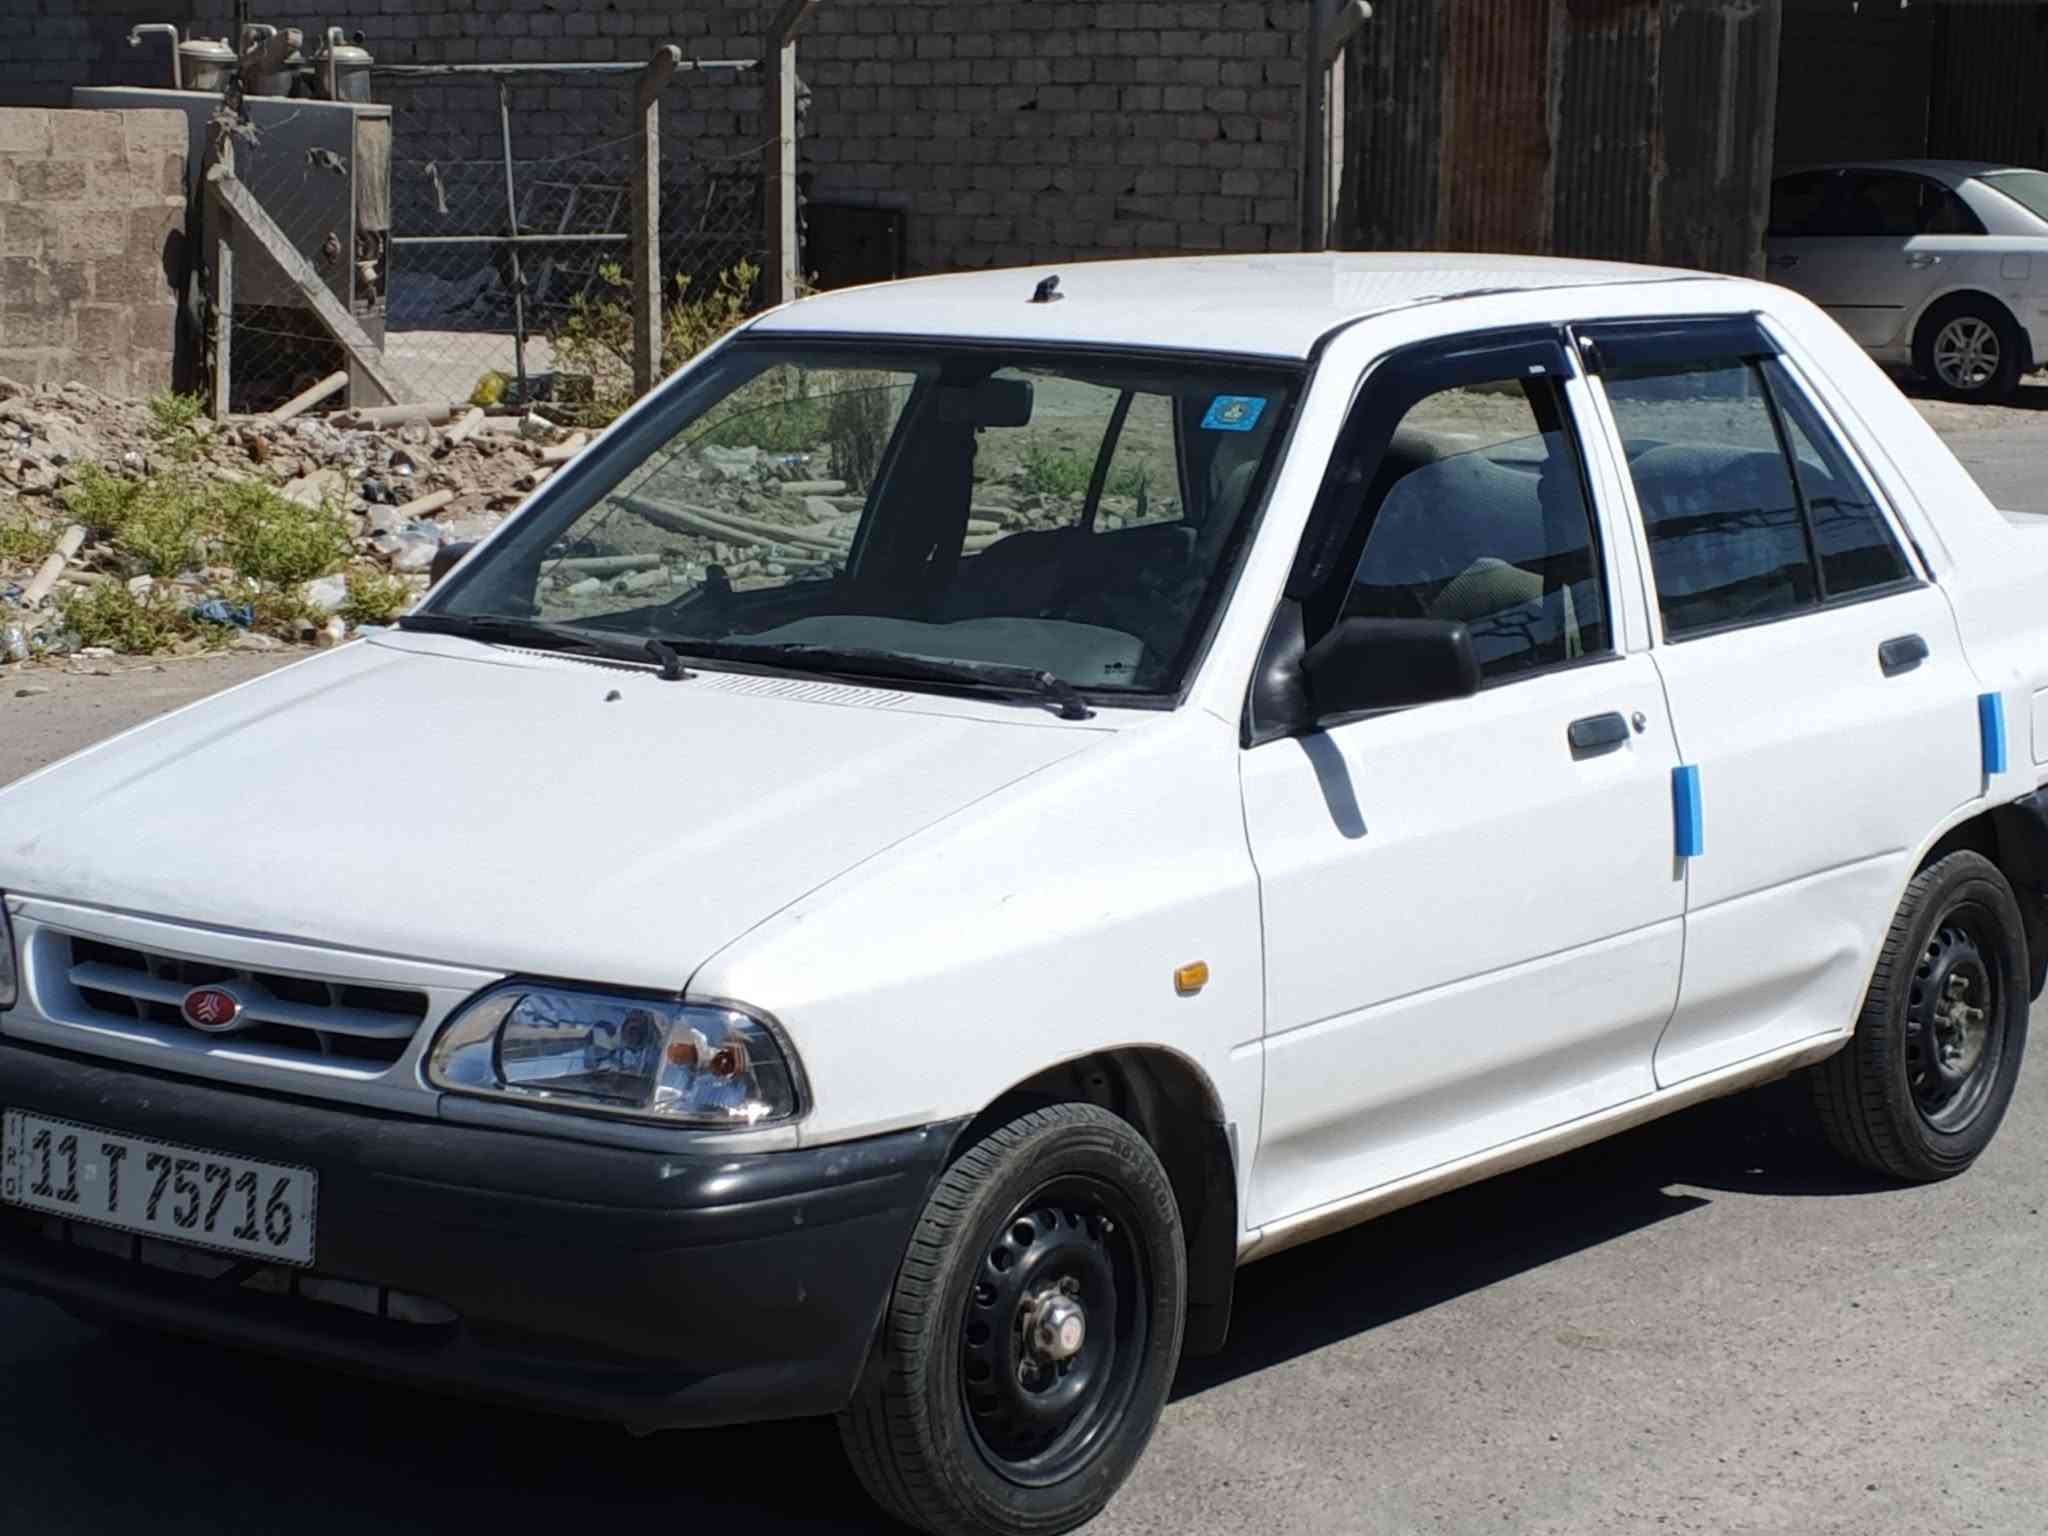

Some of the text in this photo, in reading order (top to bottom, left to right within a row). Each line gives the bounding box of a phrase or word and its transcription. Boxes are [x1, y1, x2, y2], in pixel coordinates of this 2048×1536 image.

[31, 1129, 293, 1246] 11 T 75716
